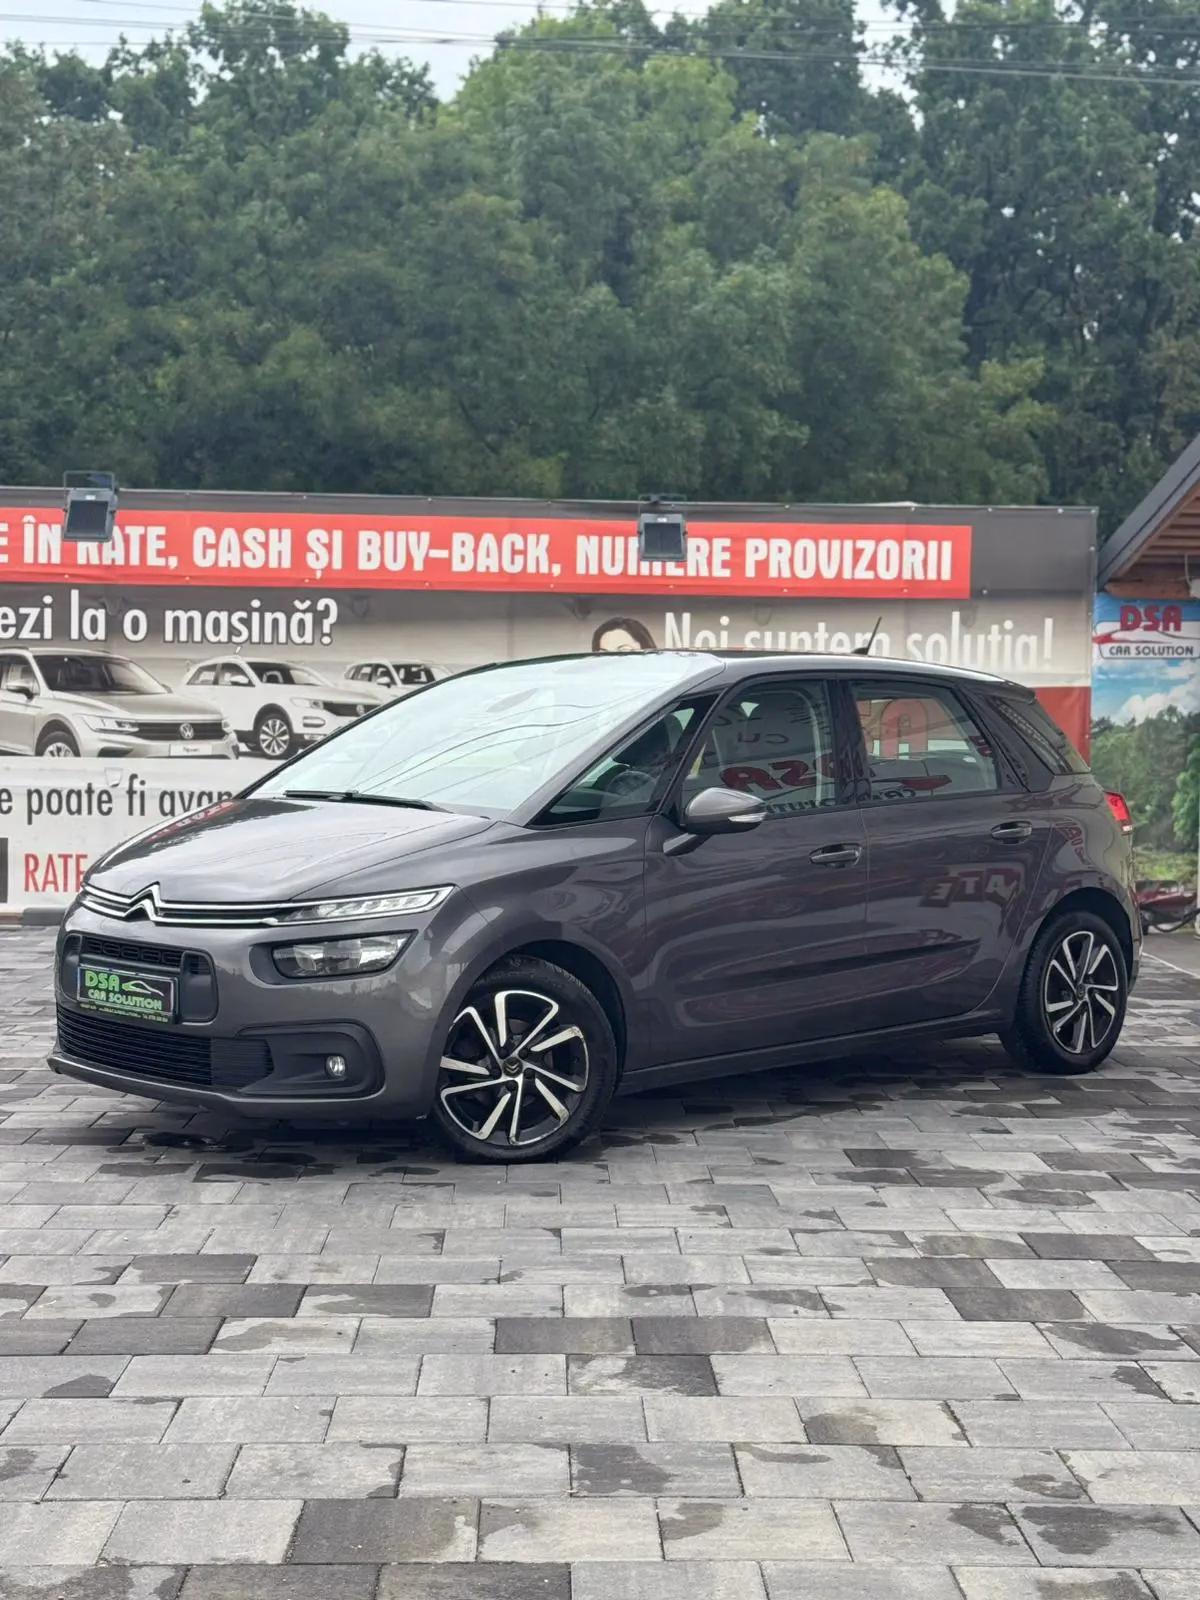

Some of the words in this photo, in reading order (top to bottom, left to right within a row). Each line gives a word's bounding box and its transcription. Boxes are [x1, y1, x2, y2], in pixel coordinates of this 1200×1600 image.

[22, 515, 61, 564] ÎN
[193, 527, 292, 568] CASH
[306, 529, 343, 579] ȘI
[744, 537, 952, 581] PROVIZORII
[71, 589, 106, 640] la
[123, 608, 148, 641] o
[1120, 604, 1182, 632] DSA
[1109, 645, 1131, 656] CAR
[1134, 645, 1195, 656] SOLUTION
[27, 782, 113, 825] poate
[126, 773, 146, 816] fi
[85, 970, 120, 992] DSA
[88, 988, 107, 1001] CAR
[108, 991, 163, 1011] SOLUTION
